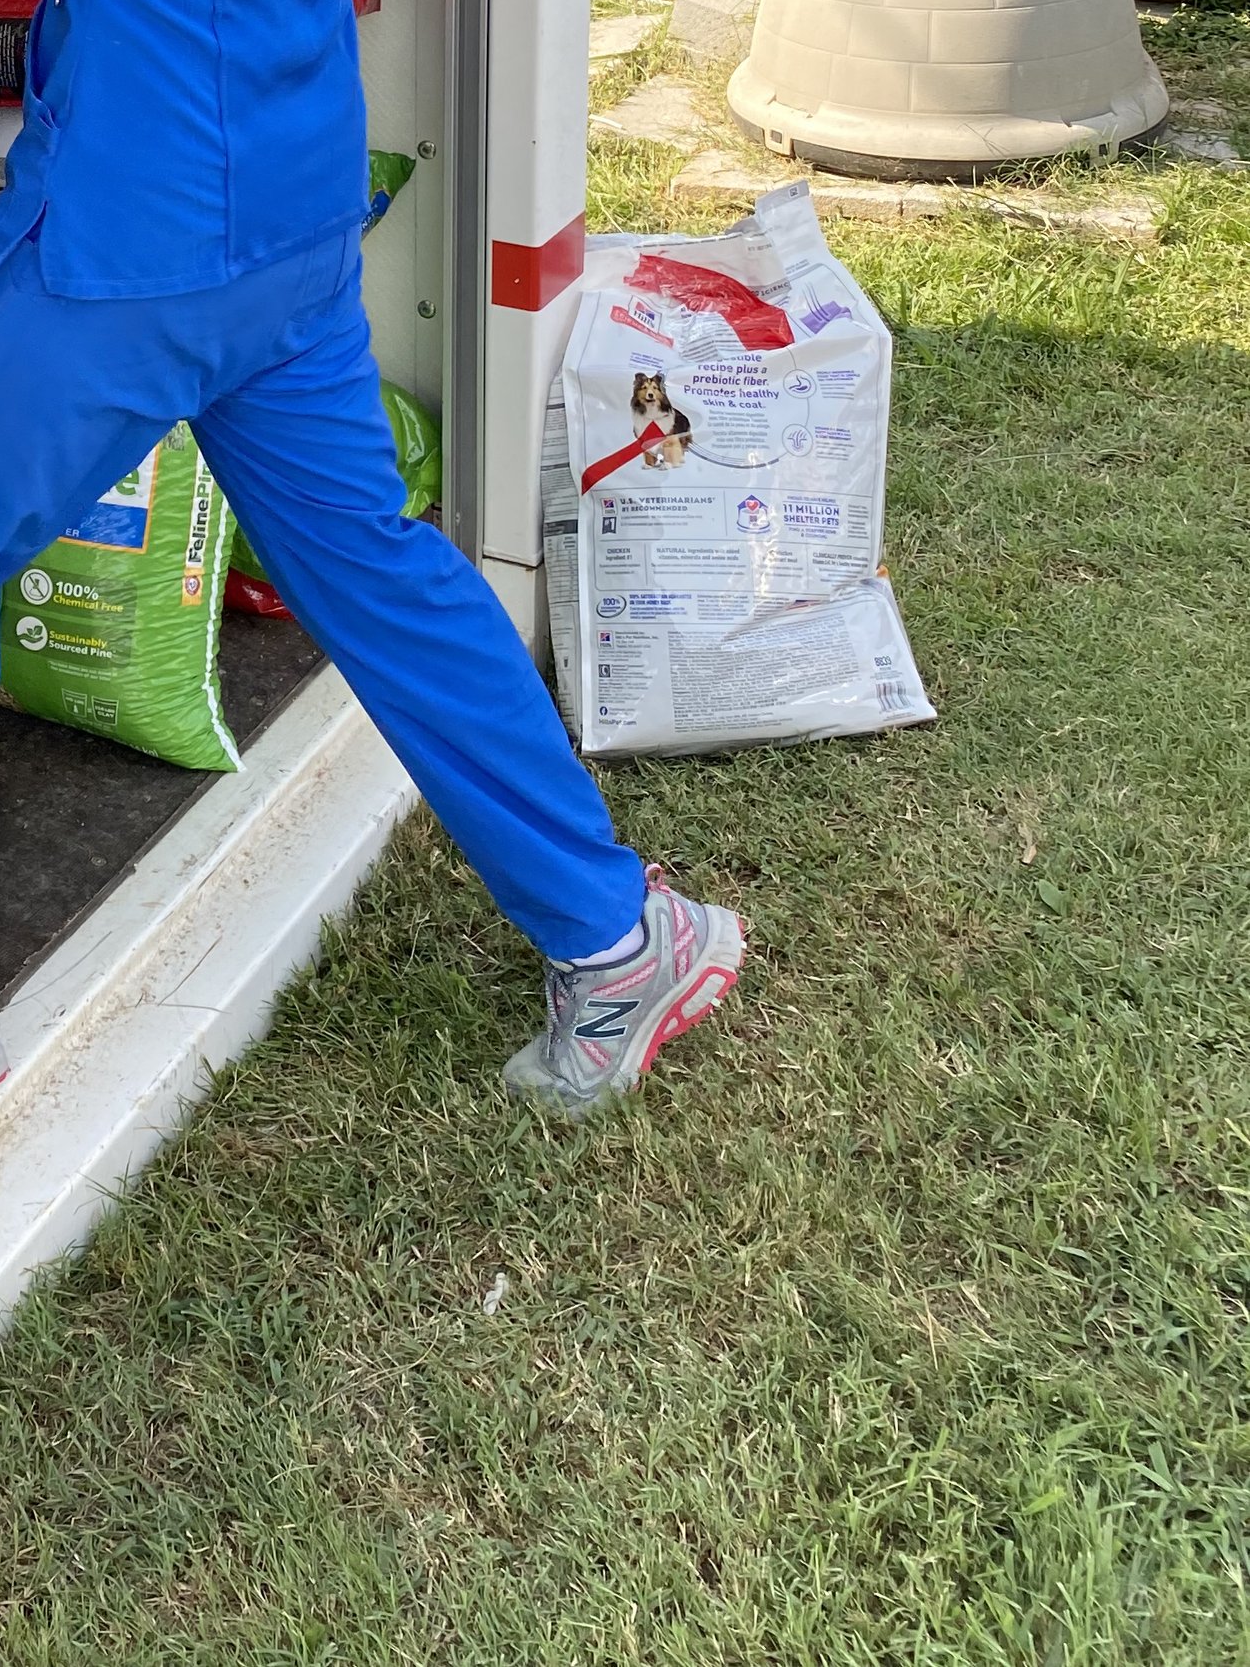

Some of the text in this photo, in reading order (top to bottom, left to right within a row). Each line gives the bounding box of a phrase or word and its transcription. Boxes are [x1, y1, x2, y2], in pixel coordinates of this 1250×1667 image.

[698, 365, 768, 376] recipe plus a
[692, 374, 769, 386] prebiotic fiber.
[684, 385, 780, 401] Promotes healthy
[703, 399, 766, 410] skin & coat.
[783, 503, 840, 516] 11 MILLION
[783, 515, 840, 526] SHELTER PETS
[55, 581, 99, 600] 100%
[53, 594, 124, 613] Chemical Free
[603, 597, 621, 606] 100%
[49, 630, 107, 649] Sustainably
[49, 639, 88, 655] Sourced
